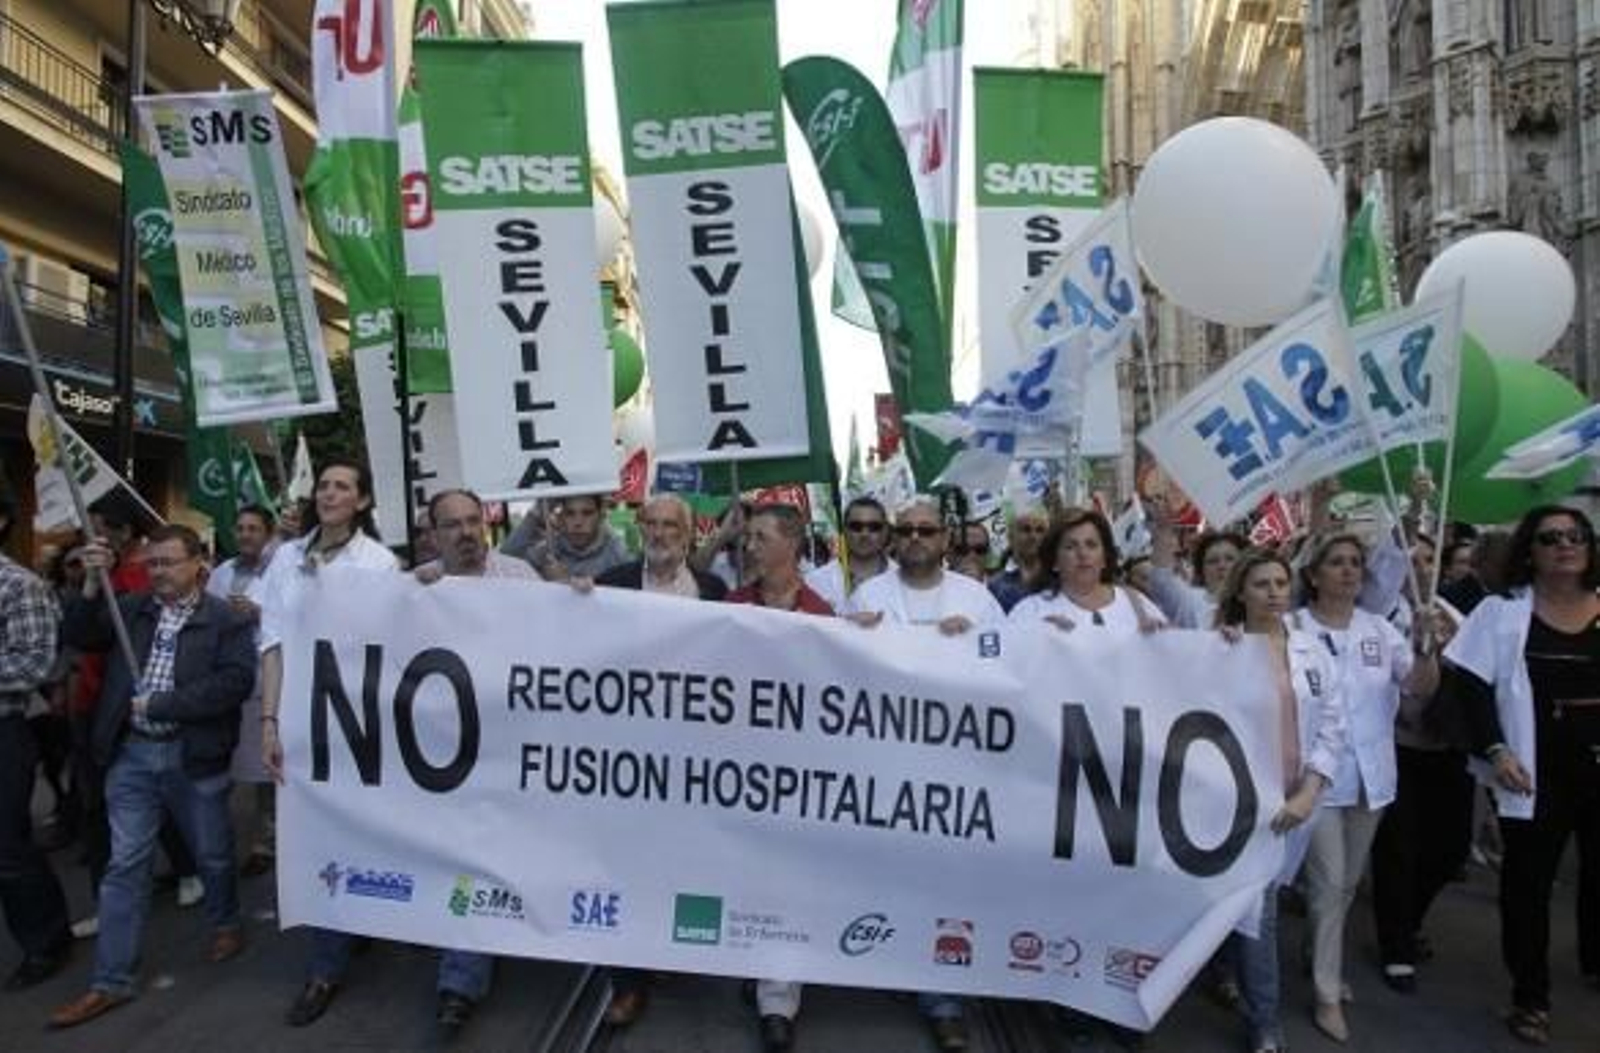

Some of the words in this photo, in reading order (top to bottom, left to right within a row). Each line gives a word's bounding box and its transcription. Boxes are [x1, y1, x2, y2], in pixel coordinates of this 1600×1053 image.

[440, 155, 584, 195] SATSE
[632, 111, 776, 160] SATSE
[983, 162, 1098, 197] SATSE
[174, 189, 253, 214] Sindicato
[190, 310, 217, 328] de
[220, 304, 277, 330] Sevilla
[495, 218, 569, 489] SEVILLA
[687, 181, 759, 450] SEVILLA
[311, 639, 480, 794] NO
[507, 664, 734, 727] RECORTES
[750, 679, 805, 732] EN
[818, 684, 1017, 754] SANIDAD
[519, 743, 670, 804] FUSION
[684, 757, 996, 843] HOSPITALARIA
[1052, 702, 1258, 878] NO
